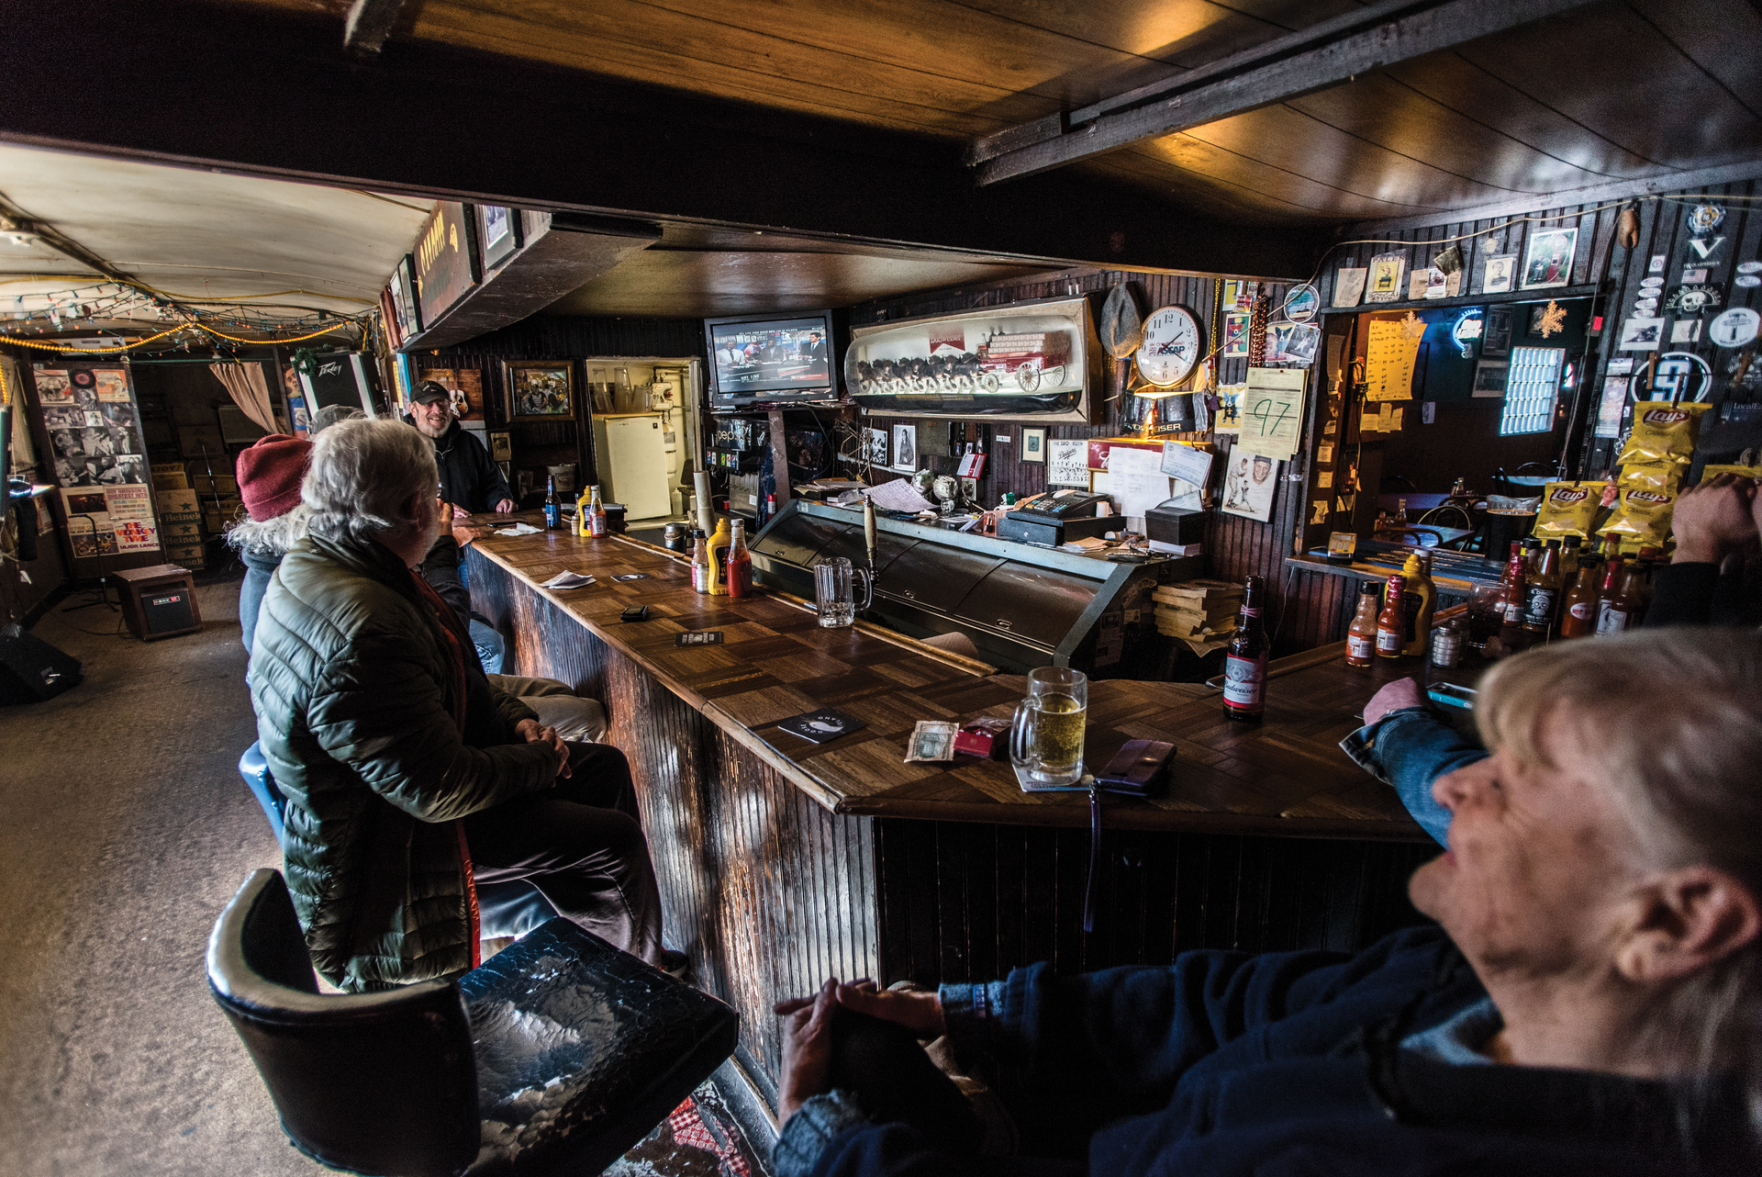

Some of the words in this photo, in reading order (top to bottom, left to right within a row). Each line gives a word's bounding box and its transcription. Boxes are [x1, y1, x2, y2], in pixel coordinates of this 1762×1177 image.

[1689, 236, 1726, 259] V
[1164, 313, 1174, 324] 12
[1178, 317, 1182, 327] 1
[1153, 319, 1161, 329] 11
[1146, 331, 1155, 340] 10
[1186, 328, 1192, 337] 2
[1157, 345, 1186, 355] ASCAP
[1162, 371, 1168, 379] 6
[1254, 398, 1291, 437] 97
[123, 521, 141, 529] THE
[115, 527, 155, 537] MONKEY
